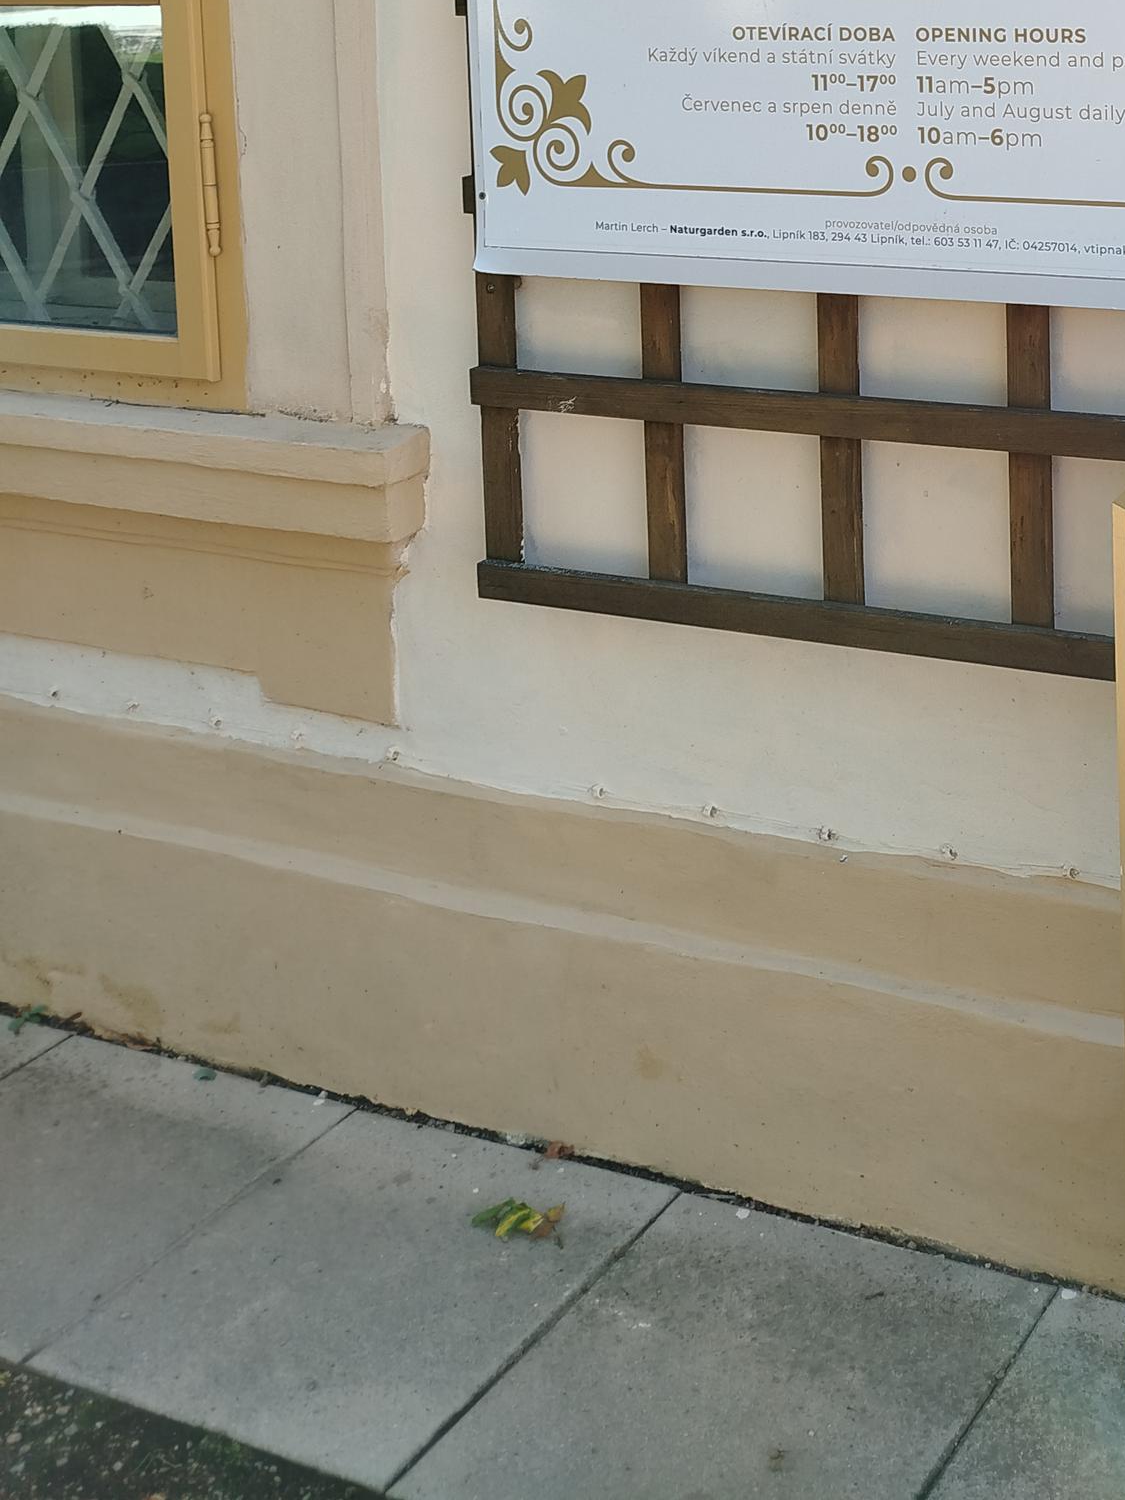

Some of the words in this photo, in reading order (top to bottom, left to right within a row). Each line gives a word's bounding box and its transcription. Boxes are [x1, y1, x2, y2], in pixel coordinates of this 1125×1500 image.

[732, 22, 833, 42] OTEVÍRACÍ
[839, 26, 896, 43] DOBA
[915, 27, 1007, 43] OPENING
[1014, 27, 1087, 44] HOURS
[917, 50, 968, 71] Every
[972, 50, 1060, 68] weekend
[1067, 51, 1105, 69] and
[916, 100, 955, 121] July
[960, 101, 996, 119] and
[1001, 102, 1073, 123] August
[1078, 103, 1125, 125] daily
[825, 219, 960, 235] provozovatel/odpovědná
[964, 224, 997, 235] osoba
[595, 221, 628, 232] Martin
[630, 222, 659, 233] Lerch
[669, 224, 739, 237] Naturgarden
[772, 229, 806, 241] Lipník
[807, 232, 829, 244] 183,
[830, 231, 851, 243] 294
[853, 232, 868, 243] 43
[870, 232, 908, 247] Lipník,
[933, 236, 955, 247] 603
[957, 237, 971, 248] 53
[972, 237, 982, 249] 11
[1022, 240, 1081, 255] 04257014,
